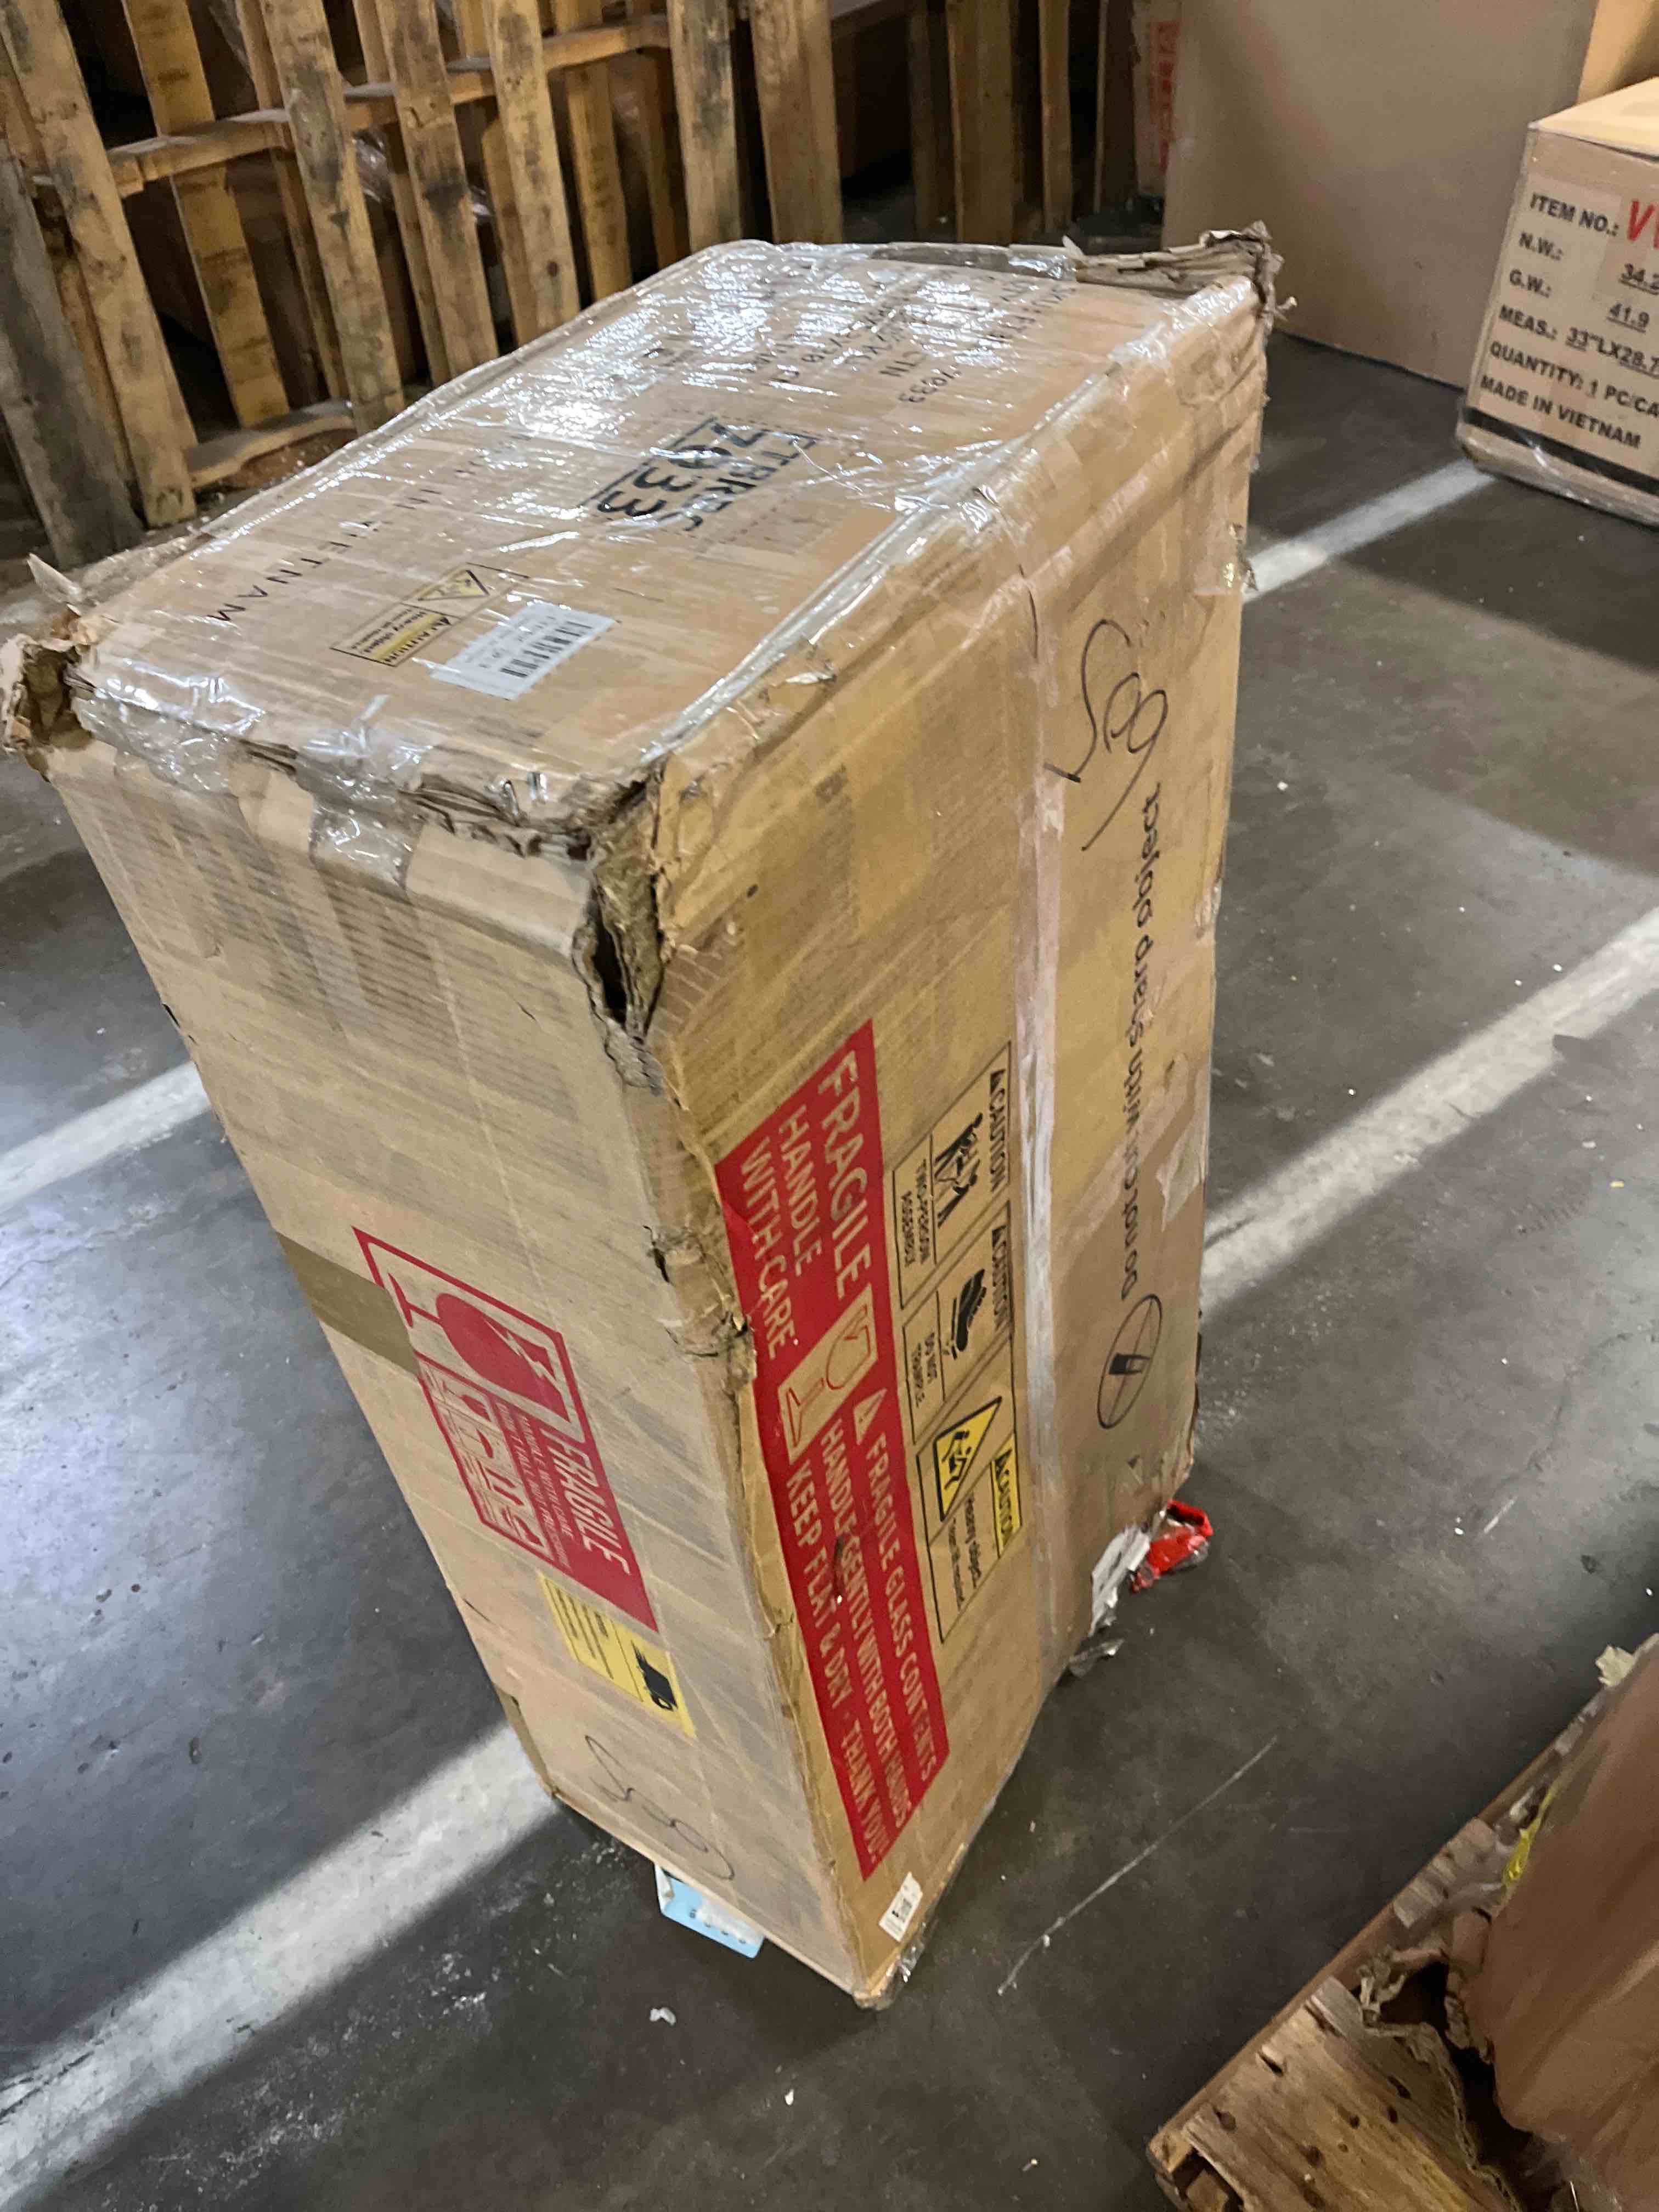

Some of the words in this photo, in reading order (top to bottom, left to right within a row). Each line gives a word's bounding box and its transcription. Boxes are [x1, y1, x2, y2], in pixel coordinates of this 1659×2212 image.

[1519, 230, 1562, 261] N.W.:
[1530, 192, 1576, 222] ITEM
[1578, 208, 1619, 236] NO.:
[1499, 304, 1558, 341] MEAS.:
[1509, 269, 1552, 298] G.W.:
[1490, 341, 1584, 391] QUANTITY:
[1480, 375, 1528, 407] MADE
[1533, 394, 1554, 415] IN
[1558, 404, 1642, 450] VIETNAM
[1133, 781, 1160, 929] object
[1126, 933, 1154, 1048] sharp
[1124, 1048, 1142, 1131] with
[820, 1051, 871, 1300] FRAGILE
[990, 1085, 1005, 1194] CAUTION
[741, 1137, 781, 1262] WITH
[778, 1104, 822, 1279] HANDLE
[1122, 1188, 1138, 1248] not
[758, 1248, 794, 1361] CARE
[1120, 1250, 1137, 1300] Do
[539, 1427, 631, 1576] FRAGILE
[786, 1457, 822, 1551] KEEP
[803, 1543, 837, 1630] FLAT
[839, 1530, 873, 1642] GENTLY
[865, 1430, 901, 1568] FRAGILE
[884, 1560, 914, 1659] GLASS
[900, 1649, 936, 1782] CONTENTS
[819, 1617, 842, 1655] &
[856, 1626, 884, 1701] WITH
[823, 1644, 853, 1712] DRY
[868, 1686, 897, 1763] BOTH
